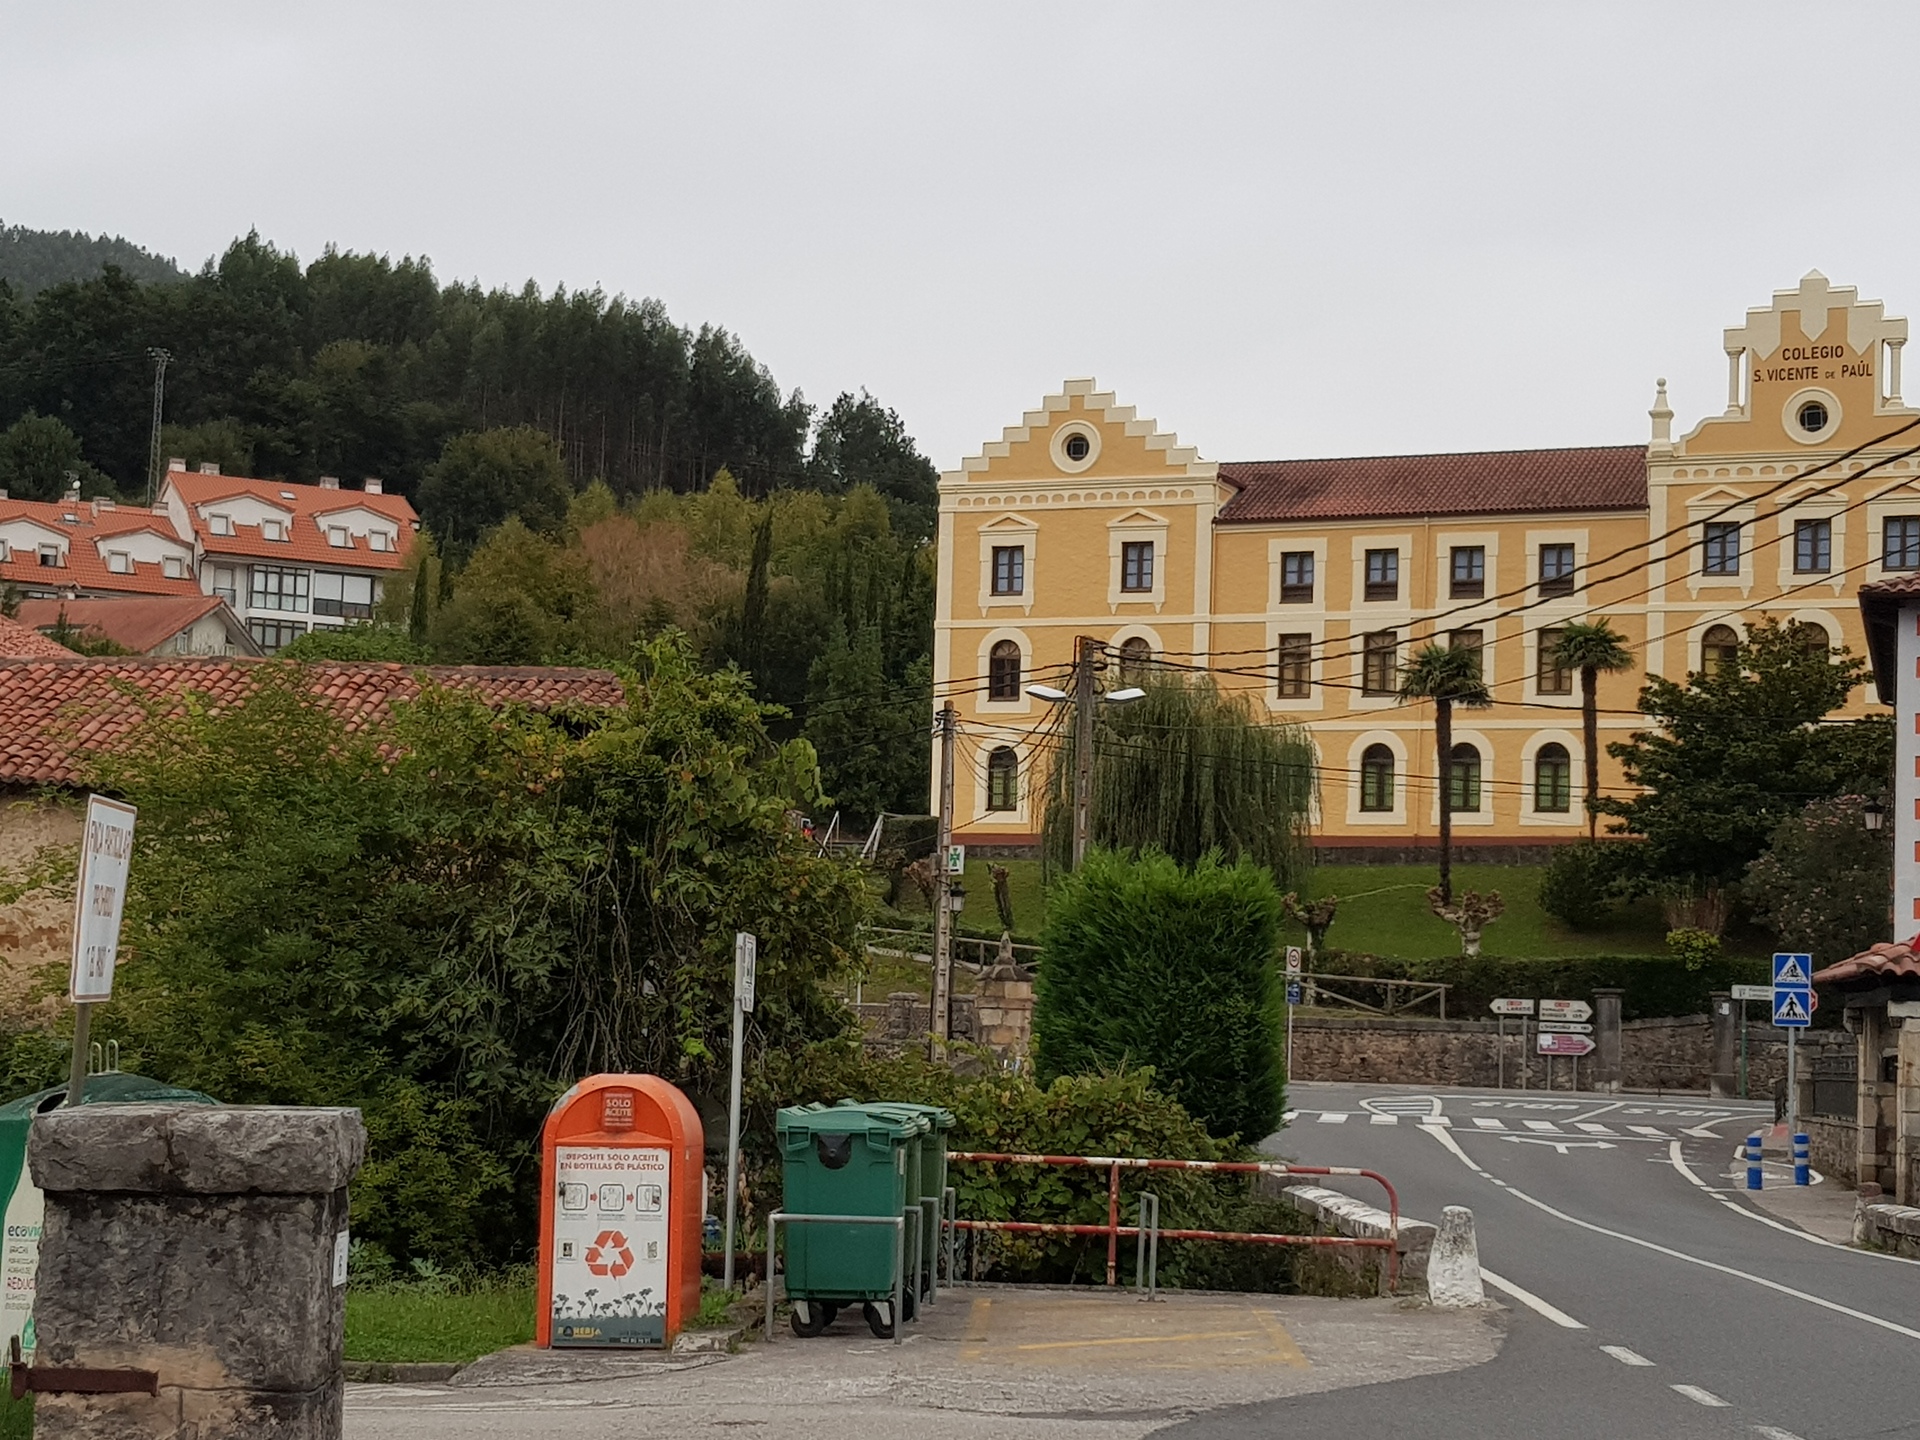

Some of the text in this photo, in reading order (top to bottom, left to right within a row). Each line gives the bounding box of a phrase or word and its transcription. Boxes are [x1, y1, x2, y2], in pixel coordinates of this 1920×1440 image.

[1782, 345, 1844, 360] COLEGIO
[1753, 369, 1764, 382] S.
[1767, 366, 1818, 381] VICENTE
[1841, 360, 1873, 378] PAÚL
[1471, 1102, 1580, 1110] STOP
[1622, 1108, 1732, 1117] STOP
[566, 1153, 604, 1161] DEPOSITE
[632, 1154, 659, 1162] ACEITE
[560, 1162, 572, 1170] EN
[573, 1162, 612, 1170] BOTELLAS
